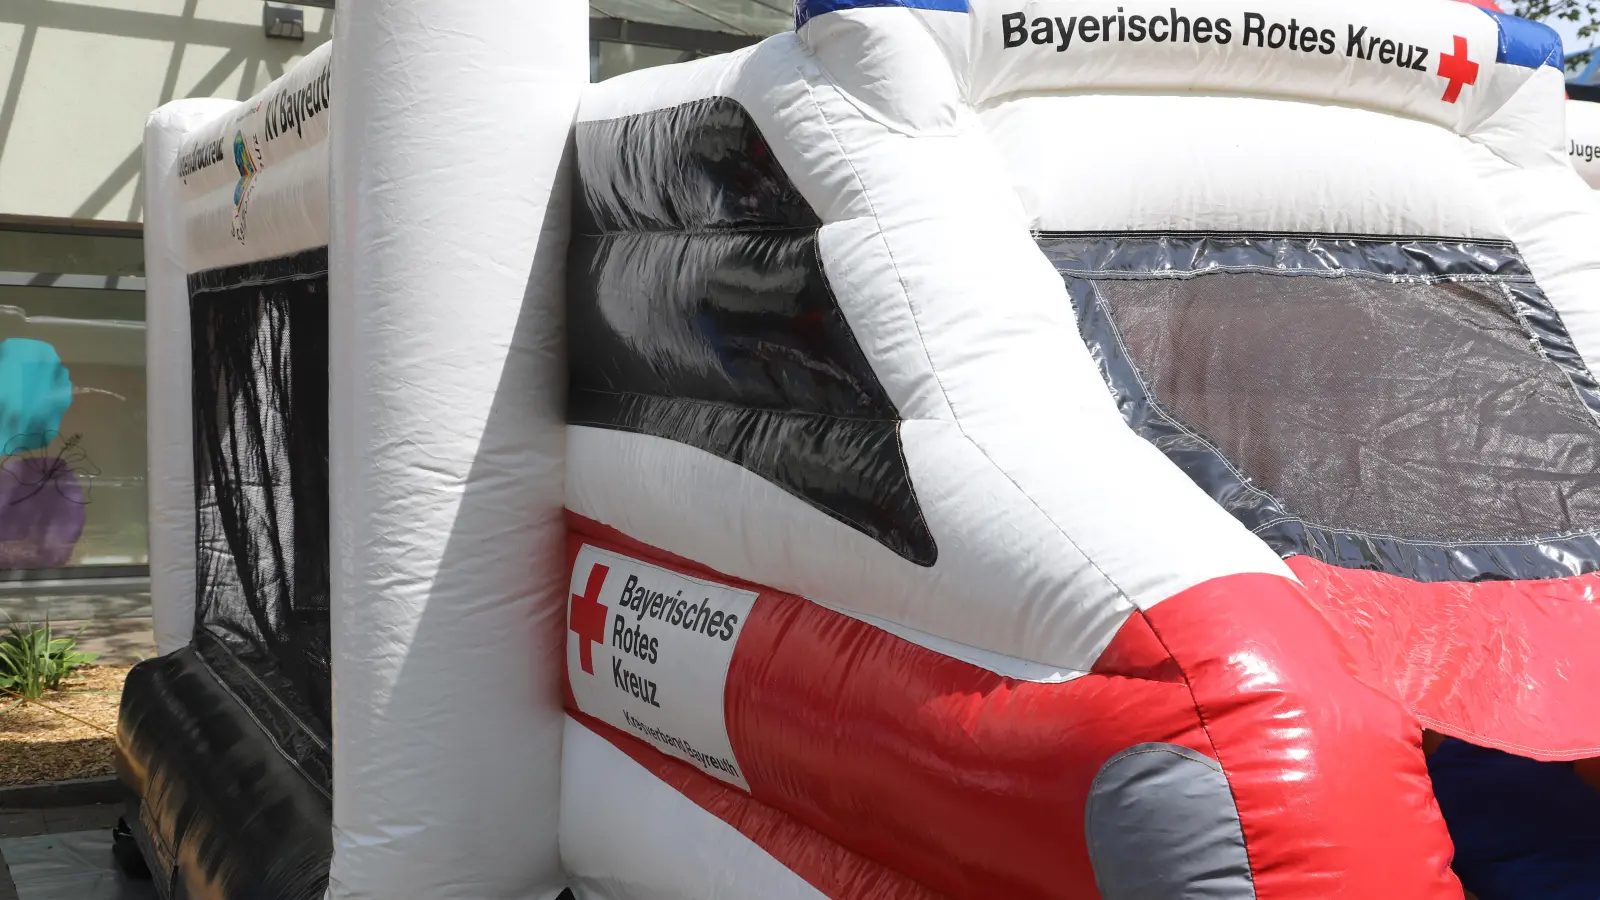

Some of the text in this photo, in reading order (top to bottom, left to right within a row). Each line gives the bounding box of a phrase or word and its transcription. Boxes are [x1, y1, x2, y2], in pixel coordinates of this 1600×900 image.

[1001, 7, 1429, 72] Bayerisches Rotes Kreuz
[265, 93, 280, 142] KV
[618, 574, 738, 642] Bayerisches
[612, 614, 659, 665] Rotes
[611, 655, 661, 708] Kreuz
[683, 740, 740, 778] Bayreuth
